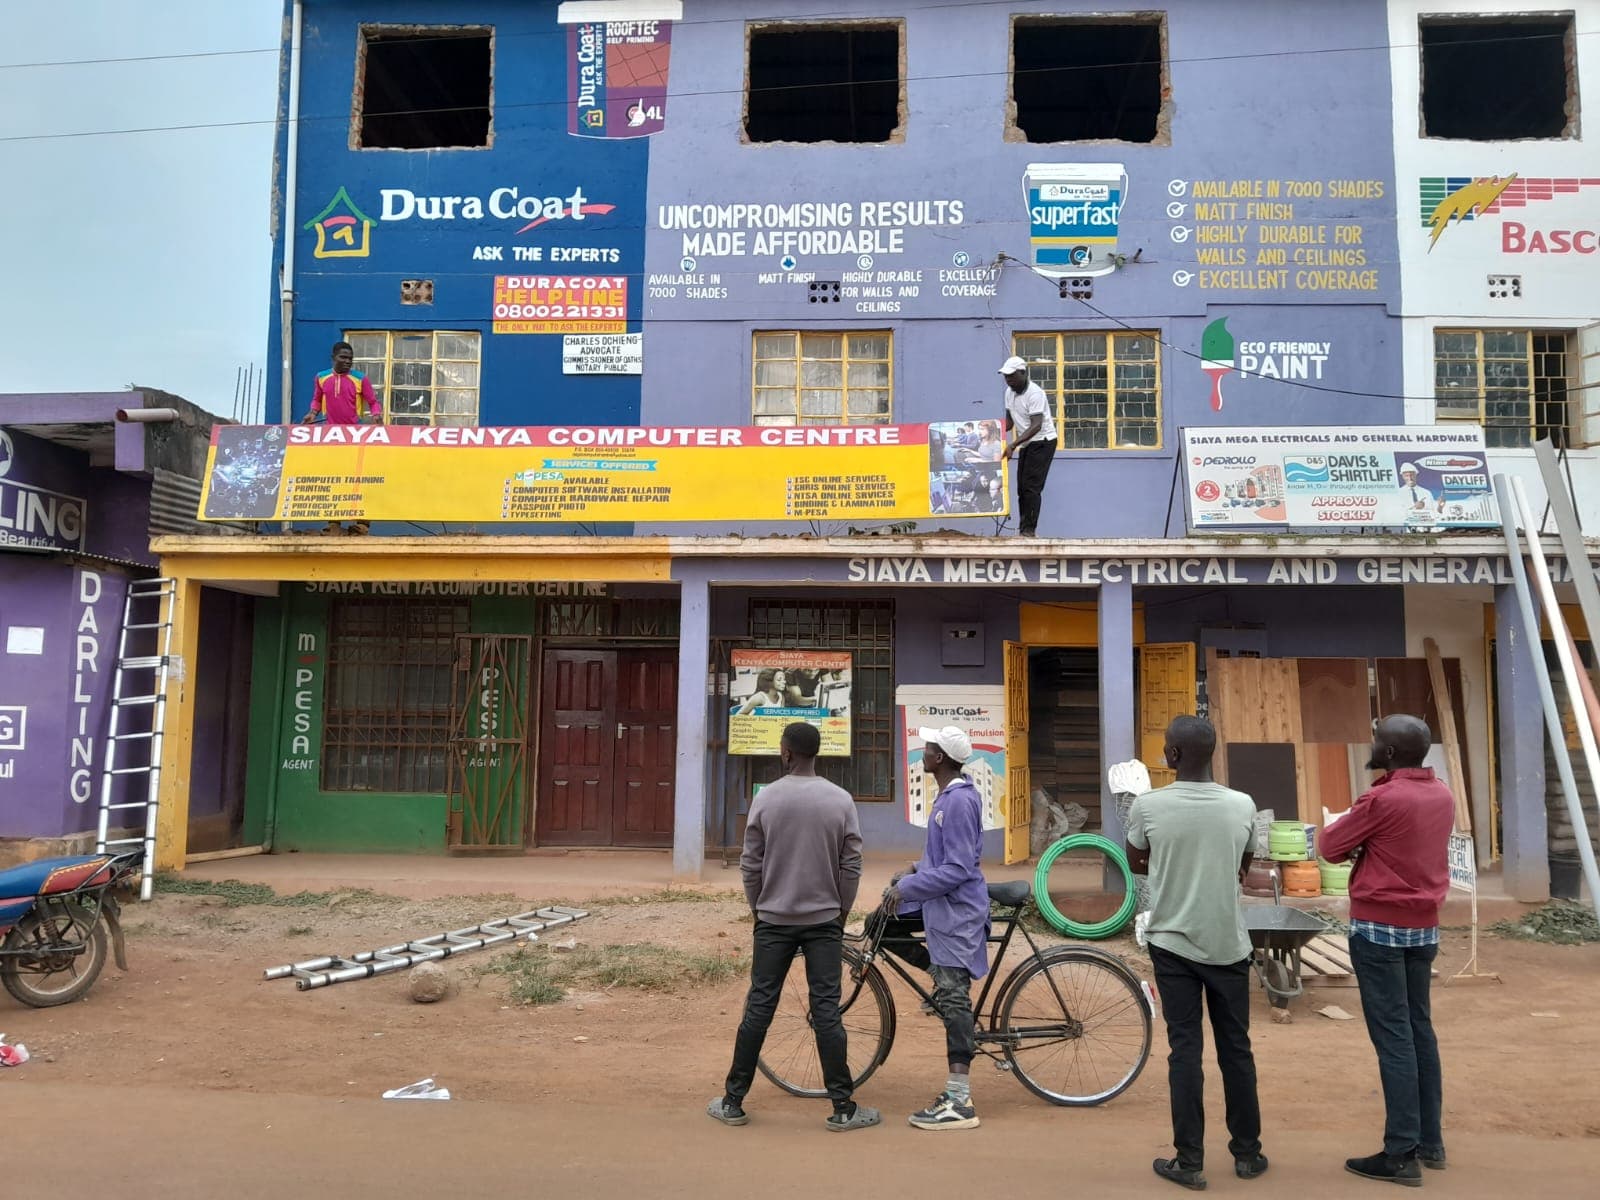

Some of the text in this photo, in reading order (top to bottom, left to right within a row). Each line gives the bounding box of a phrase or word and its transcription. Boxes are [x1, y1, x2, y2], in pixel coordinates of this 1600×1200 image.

[606, 21, 660, 36] ROOFTEC
[646, 106, 664, 120] 4L
[1192, 180, 1384, 198] AVAILABLE IN 7000 SHADES
[659, 200, 965, 230] UNCOMPROMISING RESULTS
[1031, 202, 1119, 230] superfast
[1195, 202, 1293, 221] MATT FINISH
[1196, 225, 1363, 244] HIGHLY DURABLE FOR
[1502, 221, 1600, 254] BASC
[682, 229, 904, 257] MADE AFFORDABLE
[473, 246, 620, 263] ASK THE EXPERTS
[1196, 248, 1367, 266] WALLS AND CEILINGS
[648, 274, 721, 286] AVAILABLE IN
[758, 272, 816, 284] MATT FINISH
[842, 270, 923, 283] HIGHLY DURABLE
[939, 269, 997, 282] EXCELLENT
[1200, 270, 1379, 290] EXCELLENT COVERAGE
[507, 277, 625, 289] DURACOAT
[649, 287, 728, 299] 7000 SHADES
[841, 285, 919, 298] FOR WALLS AND
[941, 283, 997, 297] COVERAGE
[495, 289, 624, 305] HELPLINE
[494, 304, 624, 318] 0800221331
[856, 301, 901, 313] CEILINGS
[496, 322, 509, 331] THE
[576, 322, 589, 331] THE
[590, 322, 623, 331] EXPERTS
[564, 335, 638, 346] CHARLES OCHIENG
[580, 346, 622, 355] ADVOCATE
[1240, 341, 1331, 356] ECO FRIENDLY
[575, 363, 628, 372] NOTARY PUBLIC
[1240, 355, 1328, 380] PAINT
[289, 426, 900, 447] SIAYA KENYA COMPUTER CENTRE
[1190, 433, 1479, 445] SIAYA MEGA ELECTRICALS AND GENERAL HARDWARE
[551, 460, 650, 470] SERVICES OFFERED
[1328, 455, 1379, 468] DAVIS &
[344, 476, 385, 484] TRAINING
[563, 477, 610, 485] AVAILABLE
[813, 475, 842, 483] ONLINE
[1330, 469, 1393, 482] SHIRTLIFF
[1444, 475, 1485, 486] DAYLIFF
[561, 486, 609, 494] SOFTWARE
[511, 494, 670, 503] COMPUTER HARDWARE REPAIR
[794, 500, 829, 508] BINDING
[840, 500, 896, 508] LAMINATION
[1312, 496, 1378, 507] APPROVED
[0, 484, 81, 541] LING
[292, 502, 338, 510] PHOTOCOPY
[510, 503, 556, 511] PASSPORT
[323, 509, 365, 517] SERVICES
[1318, 510, 1376, 521] STOCKIST
[847, 558, 931, 583] SIAYA
[943, 558, 1027, 583] MEGA
[1038, 558, 1249, 585] ELECTRICAL
[1266, 558, 1337, 584] AND
[1356, 557, 1516, 585] GENERAL
[734, 658, 765, 666] KENYA
[70, 570, 101, 804] DARLING
[929, 706, 982, 716] DuraCoat
[969, 728, 1005, 737] Emulsion
[282, 758, 314, 770] AGENT
[1449, 836, 1466, 851] EGA
[1451, 866, 1473, 887] WARE
